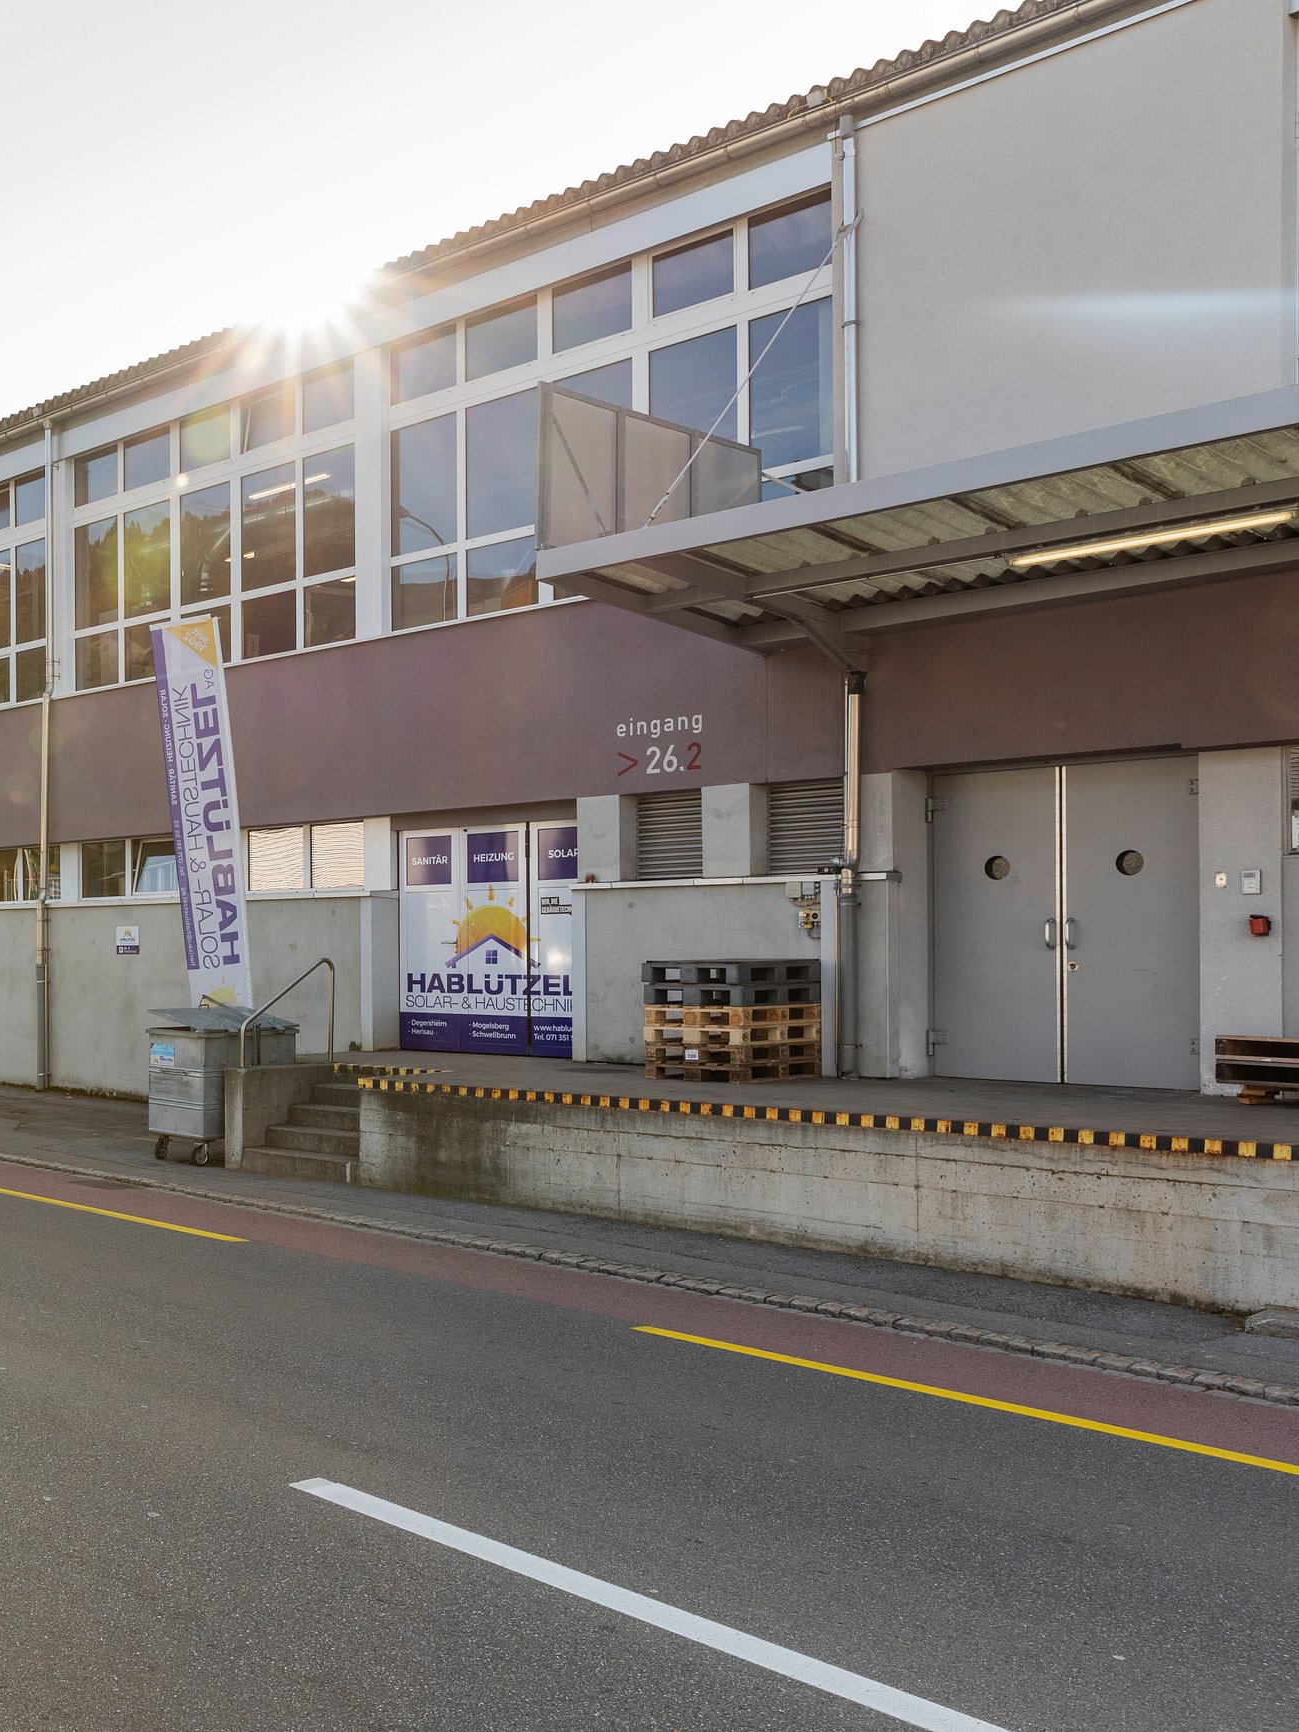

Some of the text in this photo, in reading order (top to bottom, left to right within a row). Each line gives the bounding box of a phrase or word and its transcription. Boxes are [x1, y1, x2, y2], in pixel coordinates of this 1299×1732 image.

[616, 713, 703, 738] eingang
[646, 742, 702, 775] 26.2
[411, 855, 448, 866] SANITÄR
[473, 852, 515, 863] HEIZUNG
[407, 973, 572, 996] HABLÜTZEL
[405, 995, 459, 1010] SOLAR-
[461, 996, 472, 1009] &
[411, 1019, 447, 1027] Degersheim
[472, 1022, 510, 1031] Mogelsberg
[534, 1024, 572, 1032] www.hablu
[472, 1031, 516, 1040] Schwellbrunn
[545, 1033, 557, 1041] 071
[558, 1034, 569, 1042] 351
